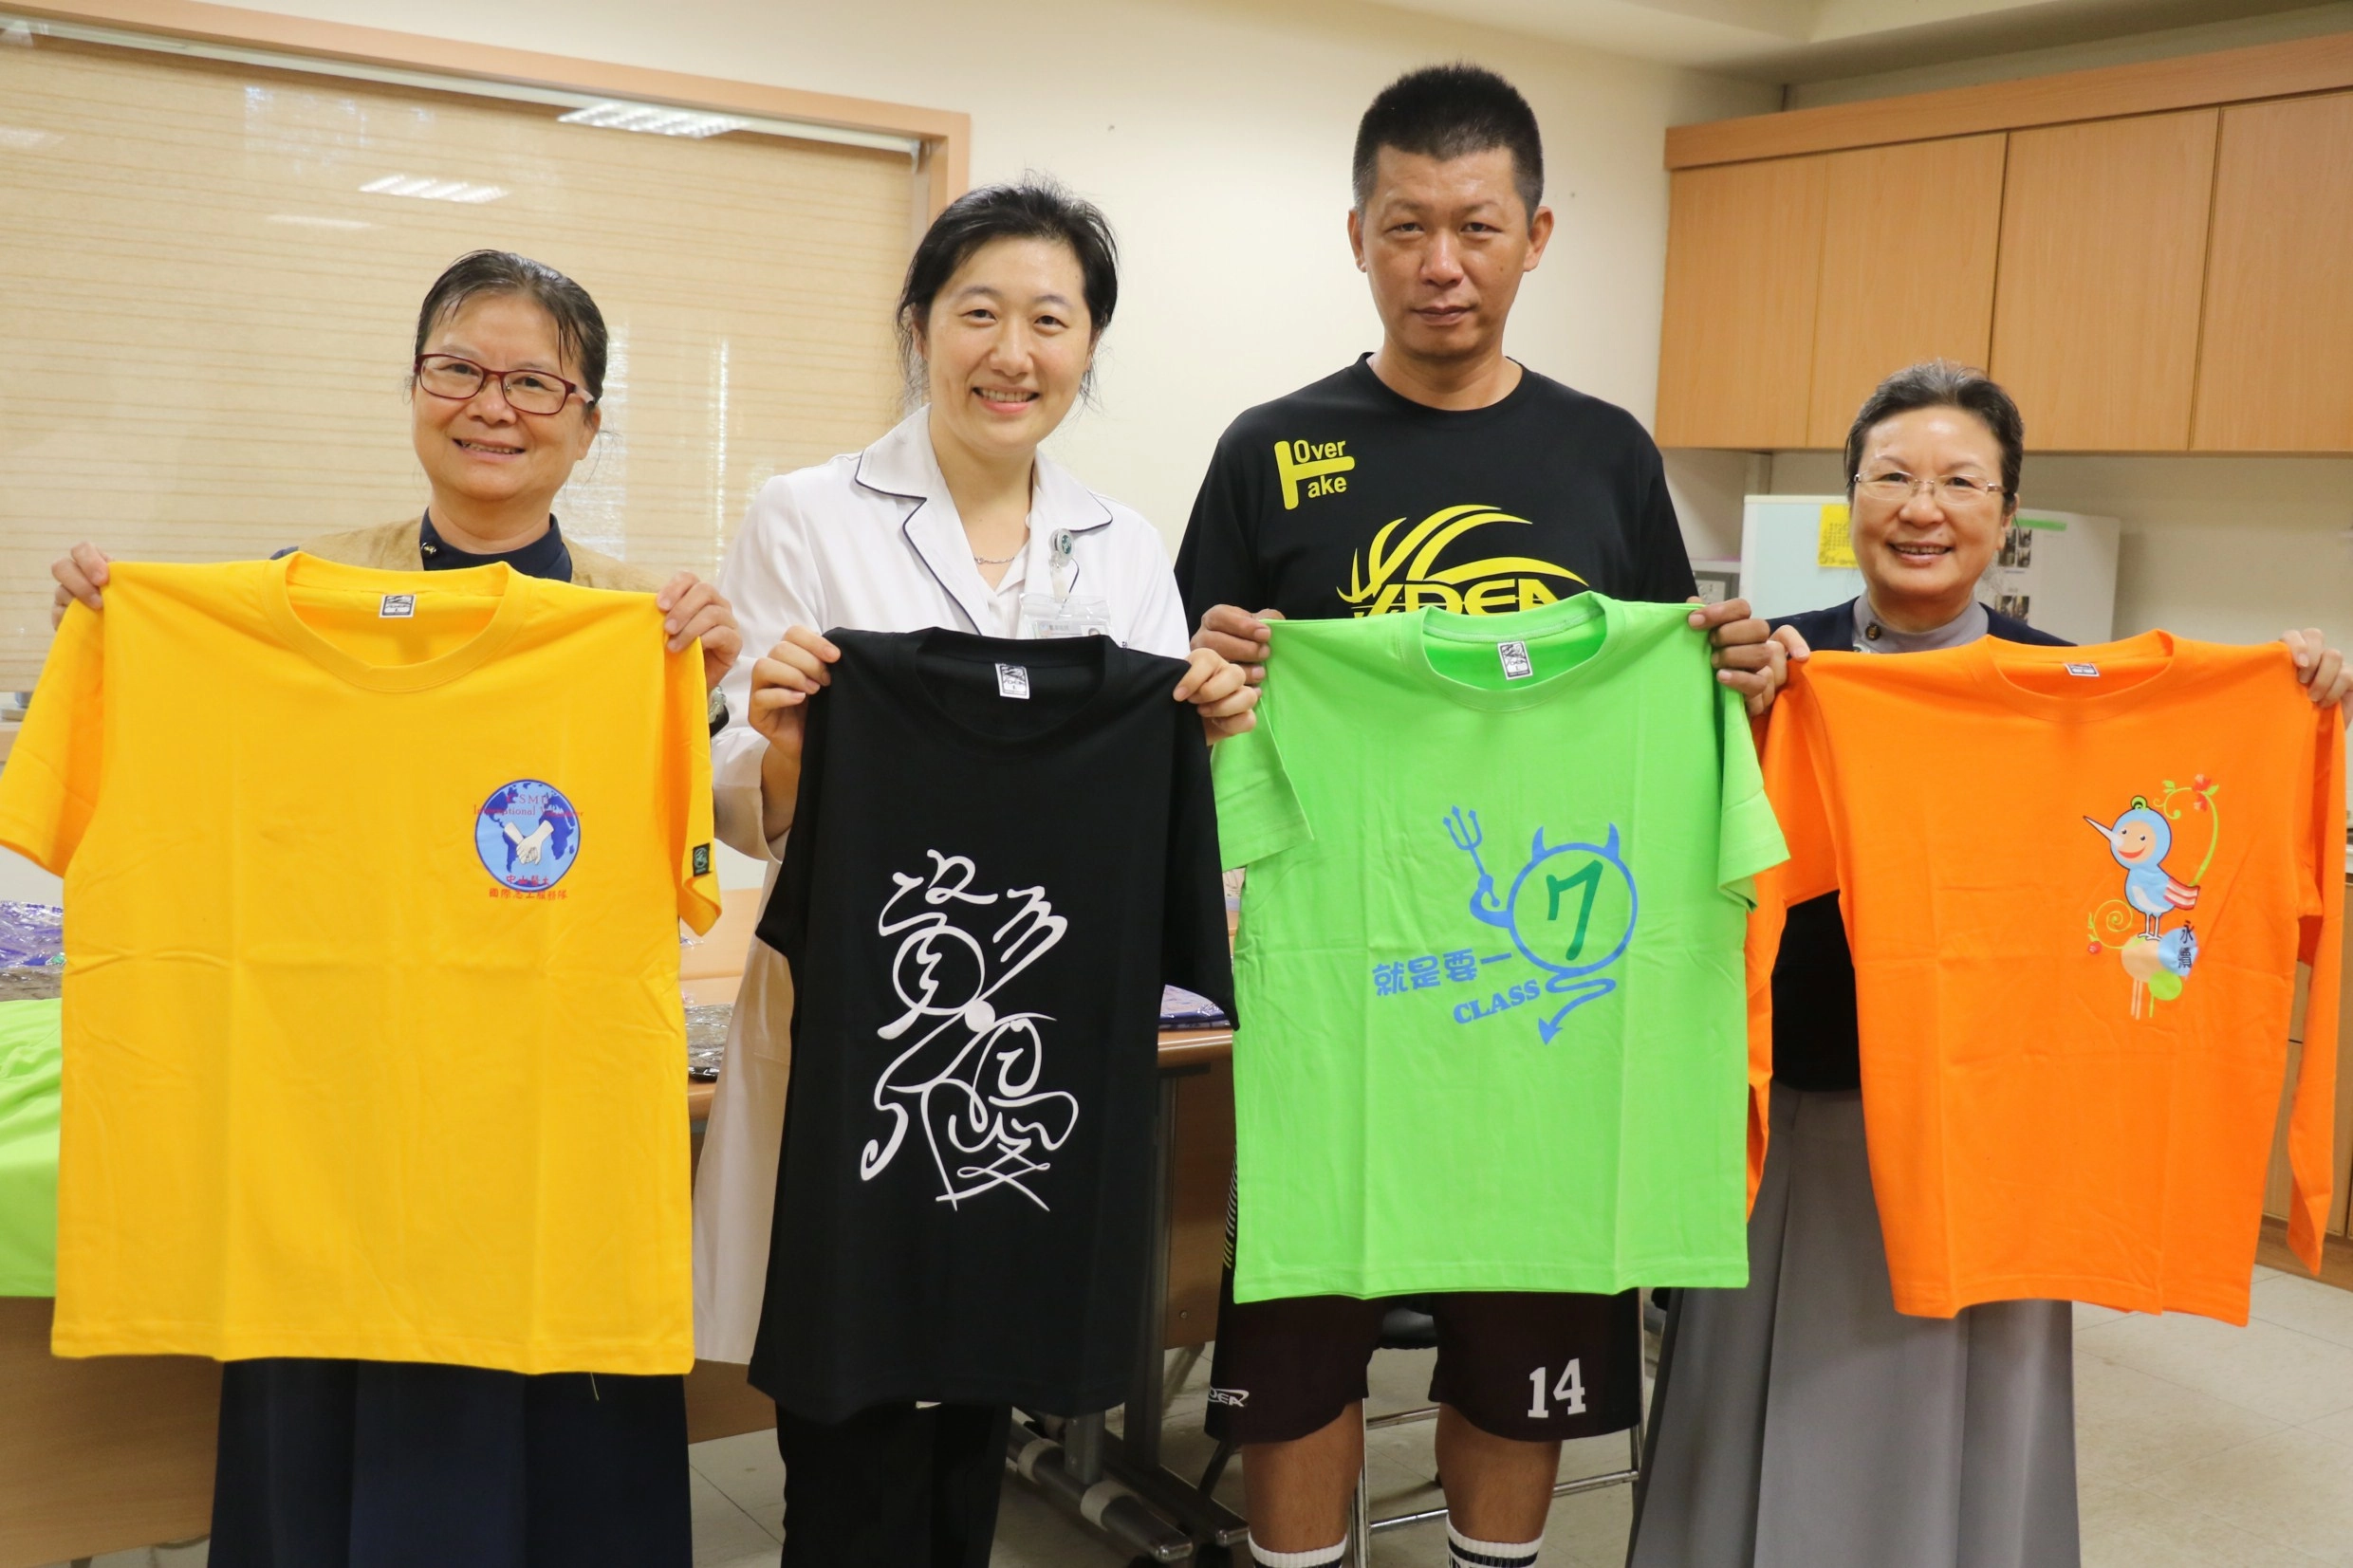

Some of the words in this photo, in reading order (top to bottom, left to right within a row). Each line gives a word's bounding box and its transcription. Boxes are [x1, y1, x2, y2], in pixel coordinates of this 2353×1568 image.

[1293, 439, 1346, 464] Over
[1546, 859, 1603, 961] 7
[1372, 949, 1512, 996] 就是要一
[1453, 979, 1542, 1024] CLASS
[1527, 1357, 1587, 1419] 14
